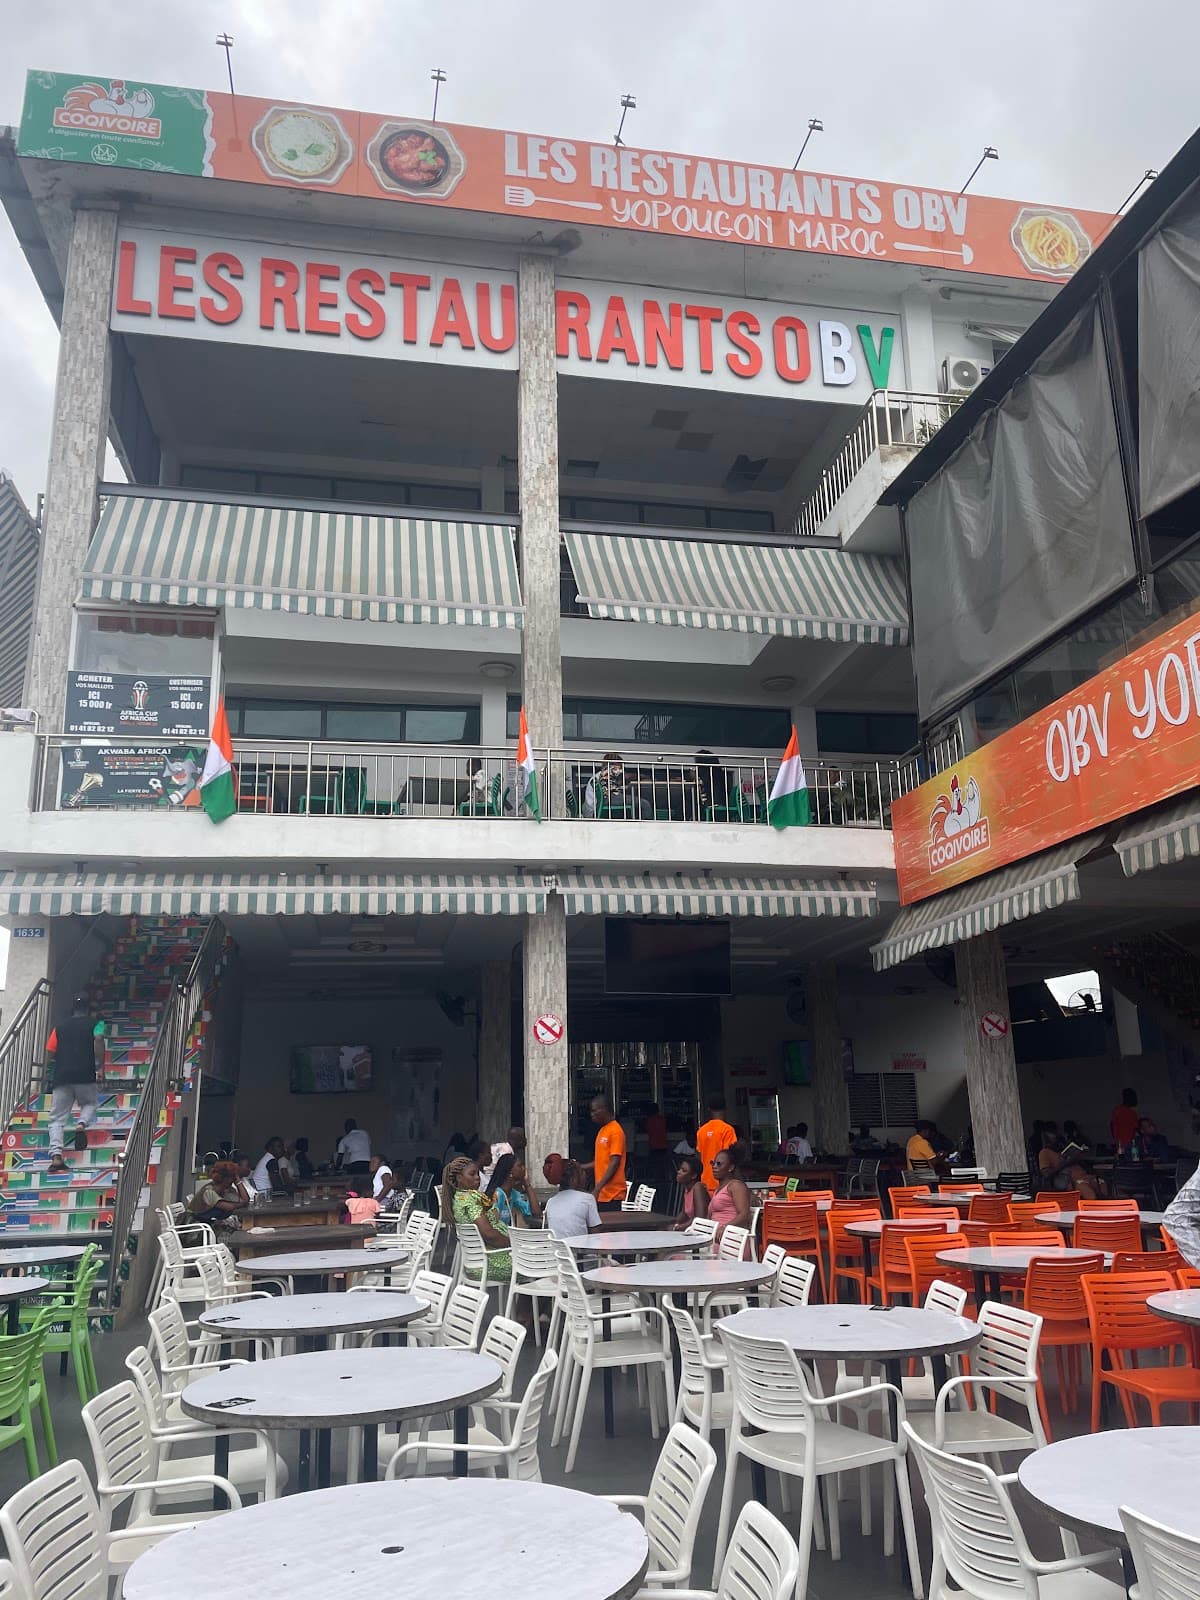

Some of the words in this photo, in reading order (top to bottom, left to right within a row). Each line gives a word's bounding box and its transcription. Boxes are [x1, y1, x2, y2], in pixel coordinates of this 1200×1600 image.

[59, 111, 159, 135] COQIVOIRE
[504, 133, 578, 184] LES
[589, 145, 882, 224] RESTAURANTS
[893, 188, 968, 236] OBV
[610, 197, 773, 245] YOPOUGON
[789, 220, 887, 256] MAROC
[115, 240, 244, 326] LES
[772, 315, 895, 390] OBV
[78, 674, 112, 683] ACHETER
[88, 691, 100, 699] ICI
[180, 693, 191, 701] ICI
[89, 700, 104, 708] 000
[171, 701, 179, 709] 15
[181, 701, 195, 709] 000
[1045, 691, 1111, 783] OBV
[930, 824, 988, 867] COQIVOIRE
[17, 928, 41, 938] 1632
